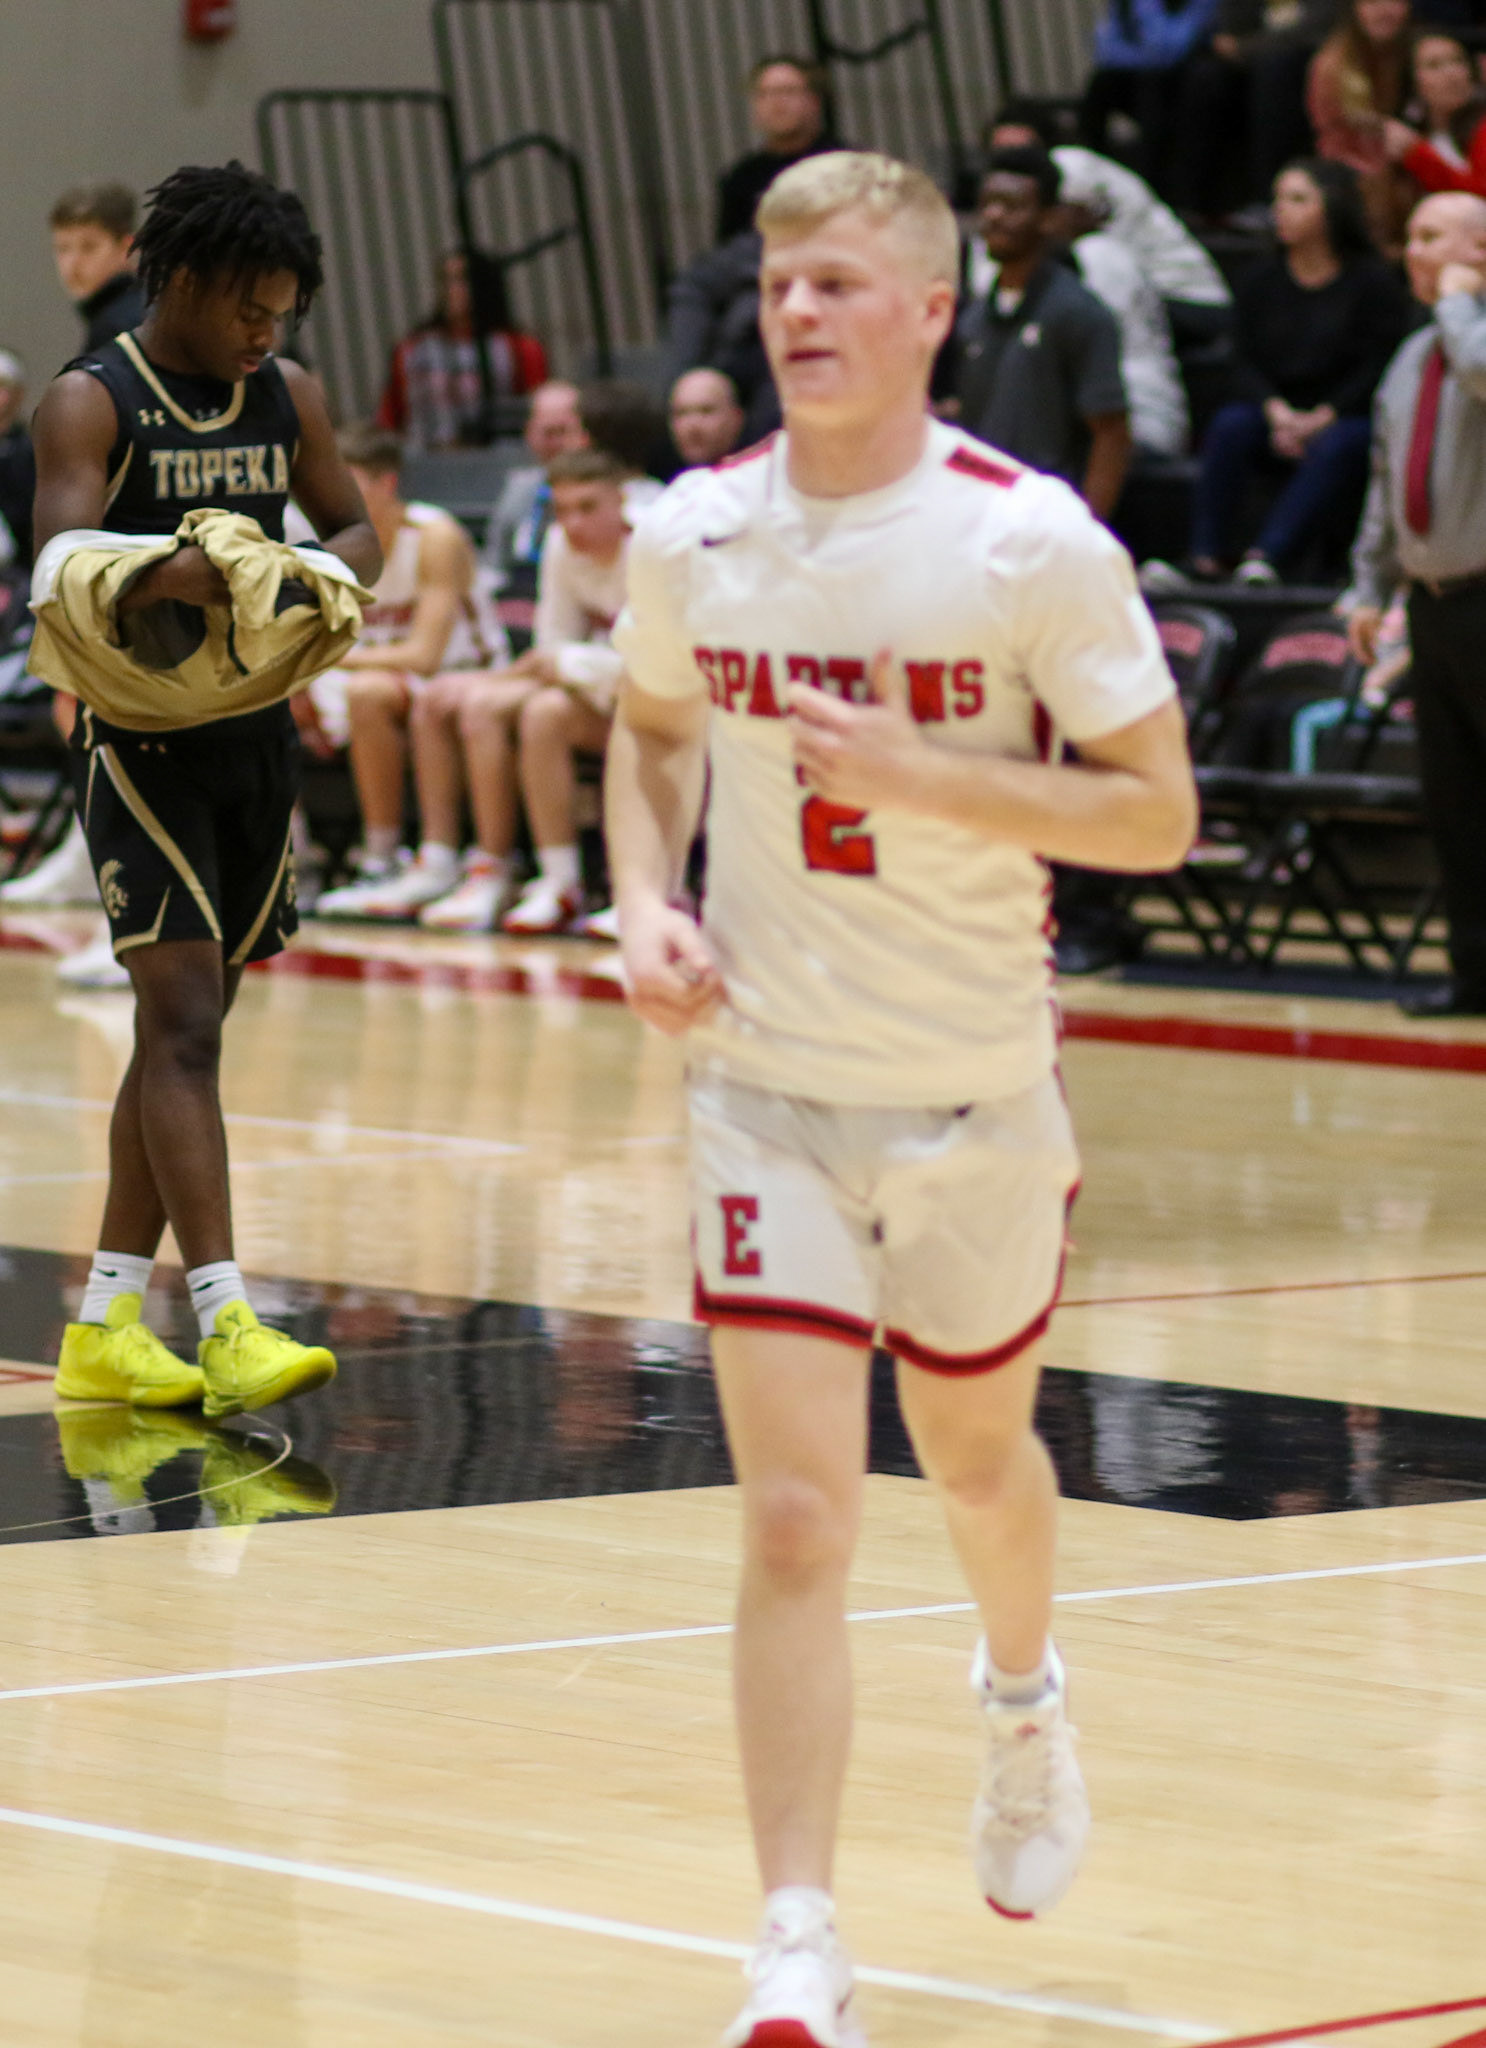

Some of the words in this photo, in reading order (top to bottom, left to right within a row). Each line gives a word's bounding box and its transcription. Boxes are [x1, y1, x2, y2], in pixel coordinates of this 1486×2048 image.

[149, 443, 289, 499] TOPEKA
[693, 645, 985, 724] SPARTNS
[794, 763, 876, 877] 2
[719, 1195, 762, 1276] E
